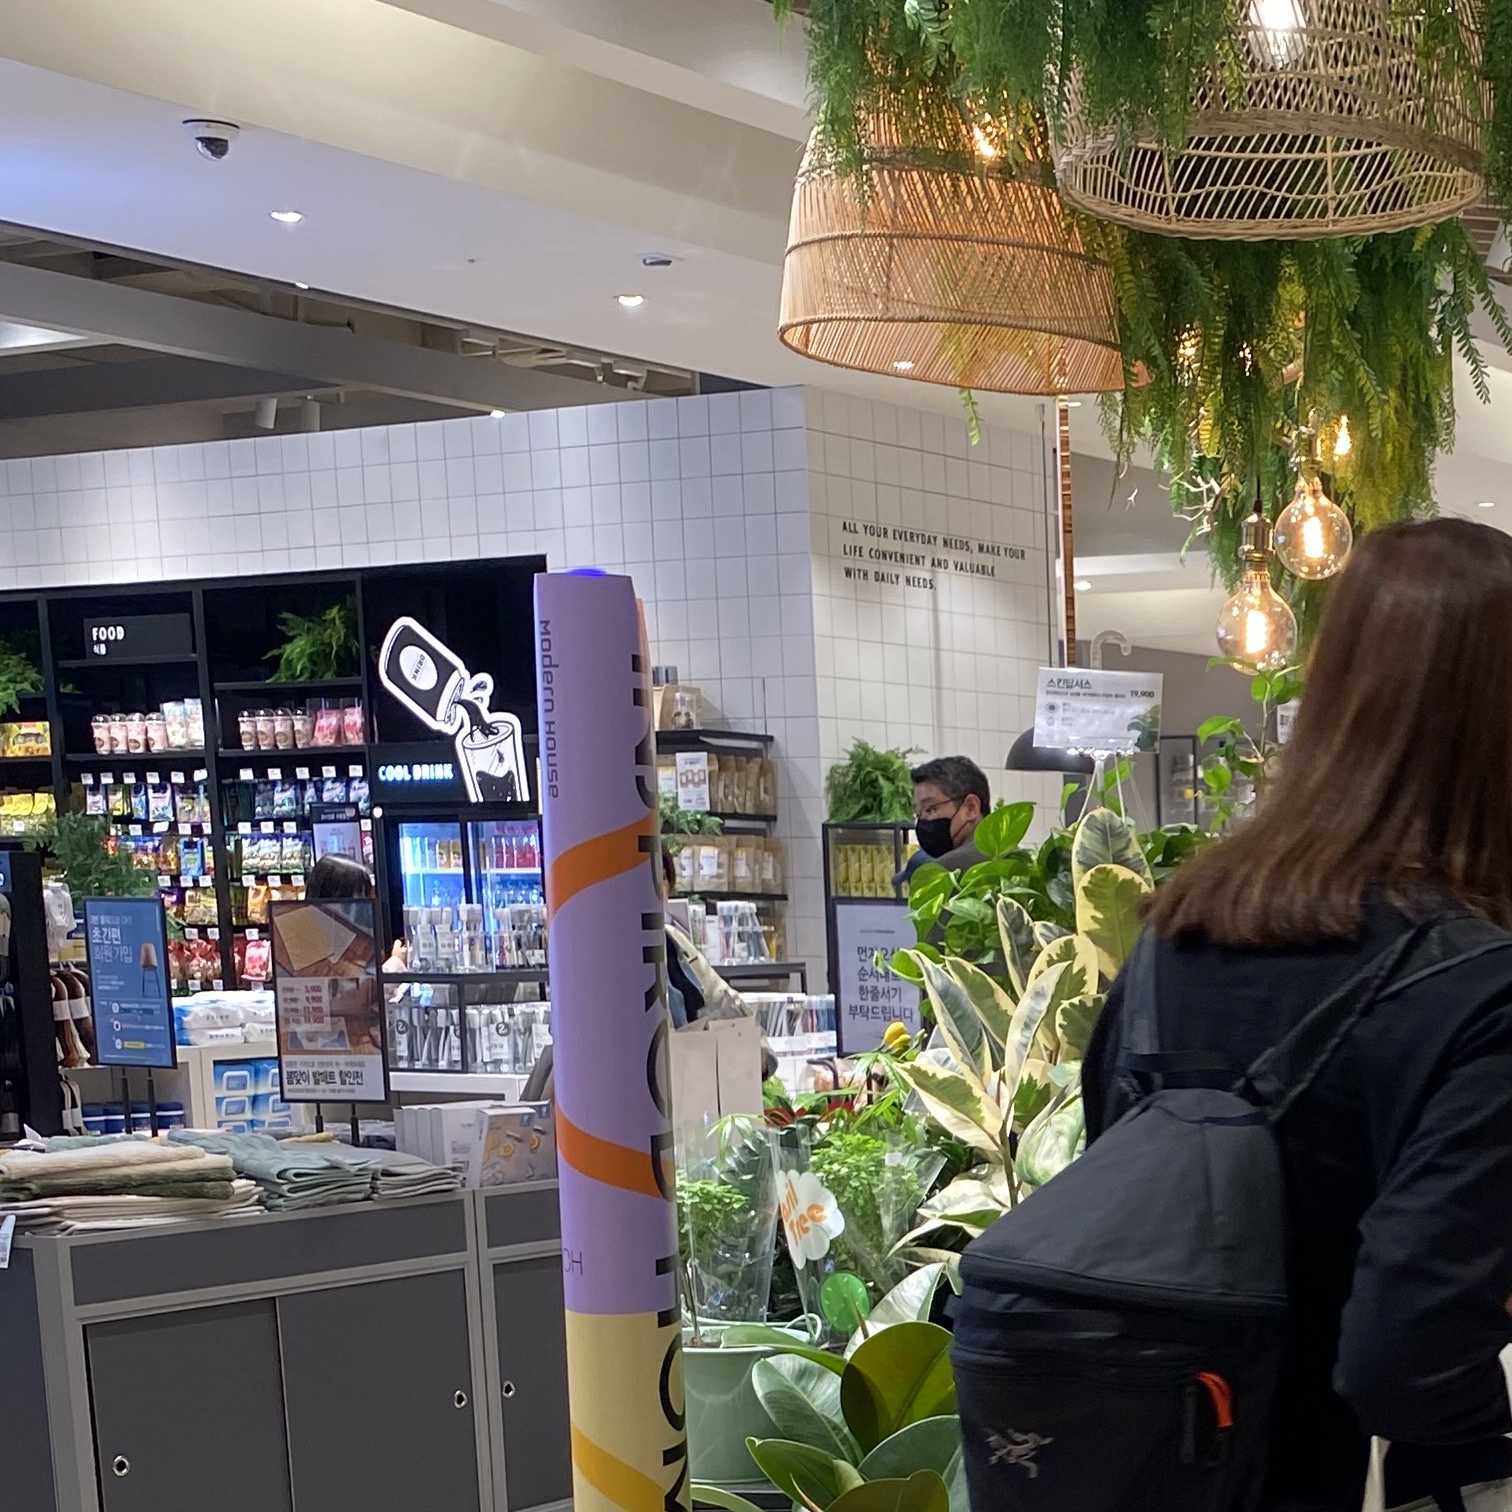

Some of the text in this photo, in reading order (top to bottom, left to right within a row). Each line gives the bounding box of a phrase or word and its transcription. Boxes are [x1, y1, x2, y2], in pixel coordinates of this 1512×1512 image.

[841, 520, 1026, 560] ALL YOUR EVERYDAY NEEDS, MAKE YOUR
[843, 543, 996, 578] LIFE CONVENIENT AND VALUABLE
[844, 566, 869, 581] WITH
[873, 570, 900, 586] DAILY
[92, 626, 125, 641] FOOD
[411, 653, 426, 682] DRINK
[378, 763, 454, 781] COOL DRINK
[858, 985, 902, 1003] 한줄서기
[848, 1003, 914, 1023] 부탁드립니다
